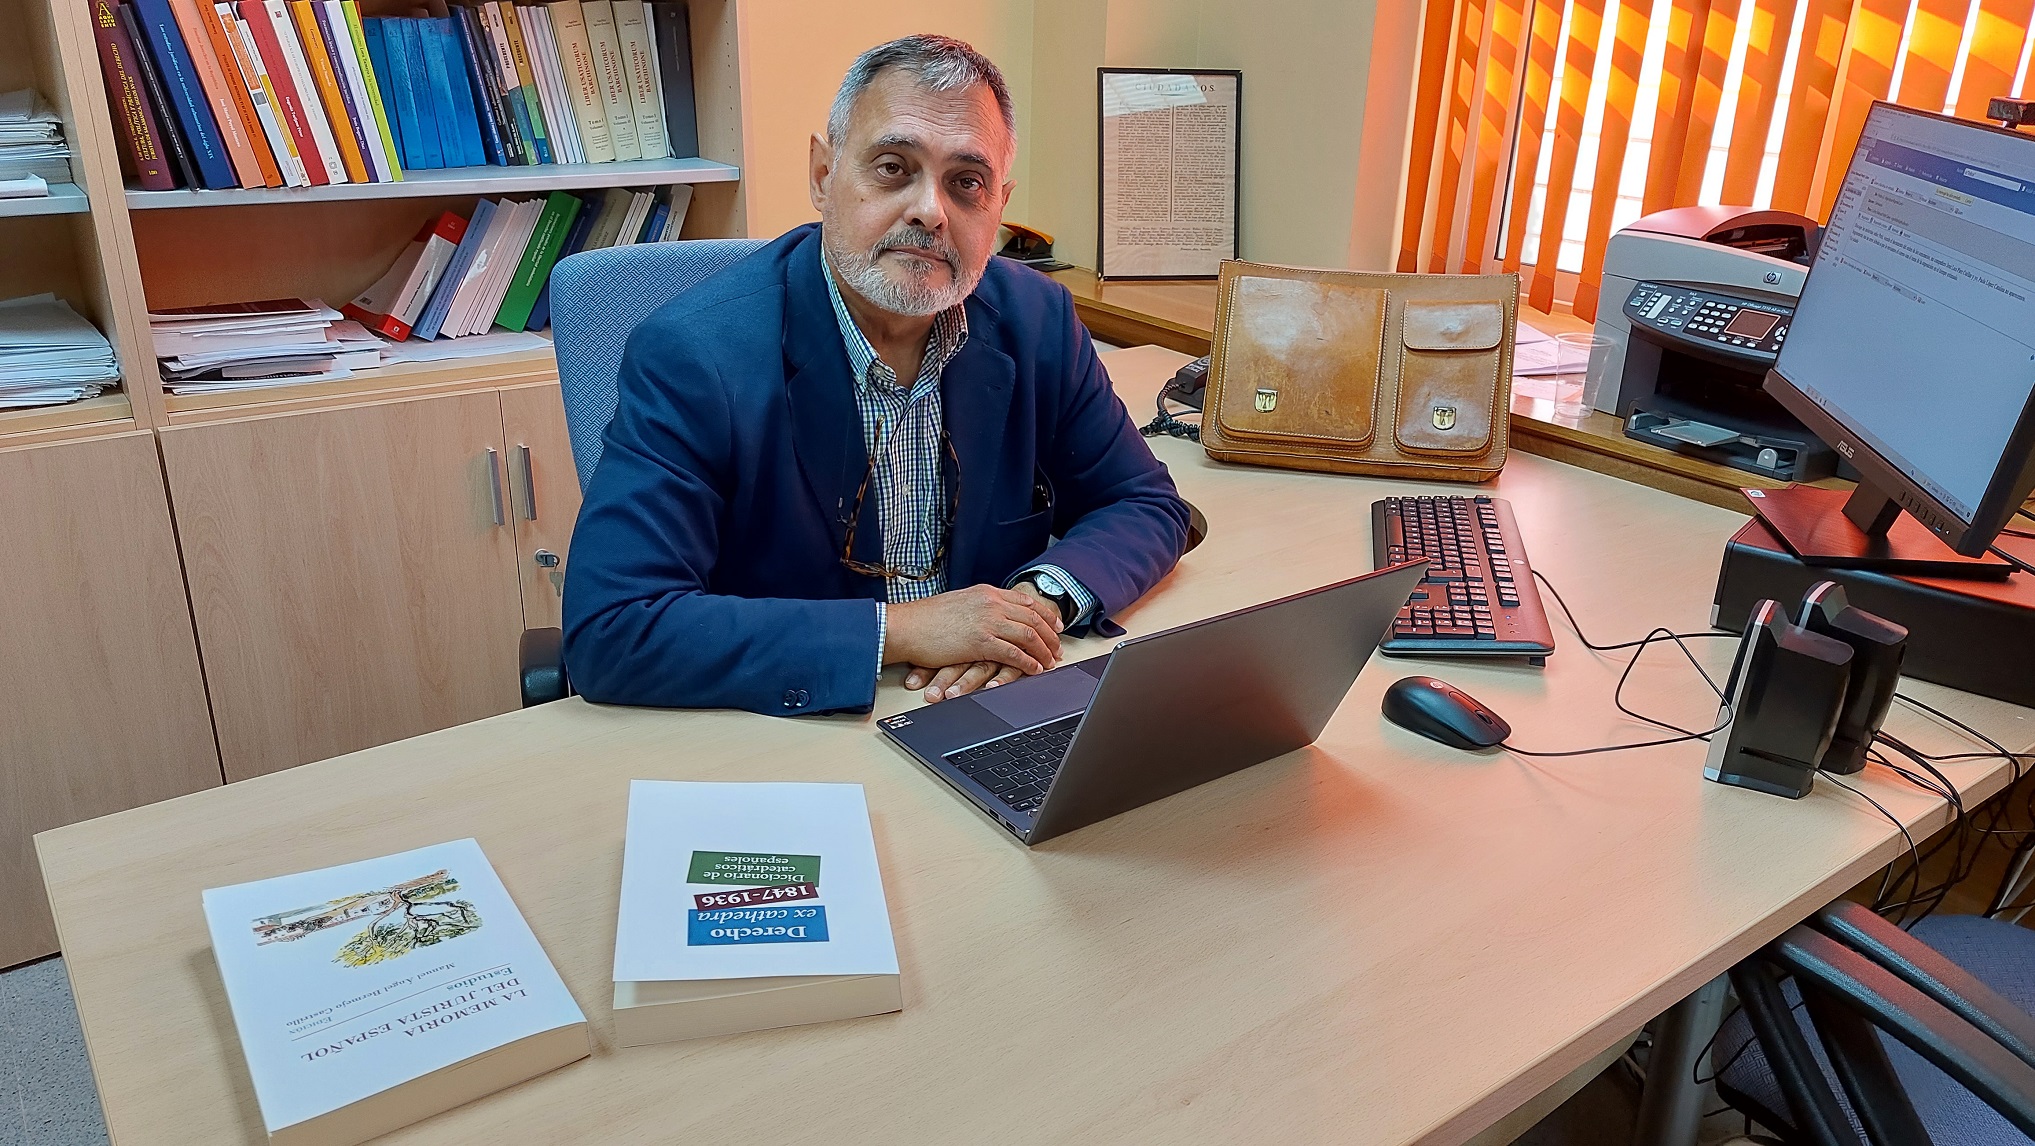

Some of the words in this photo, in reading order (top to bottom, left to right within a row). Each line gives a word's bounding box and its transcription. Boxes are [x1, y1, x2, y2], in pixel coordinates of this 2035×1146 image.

[111, 42, 122, 69] DERECHO
[572, 42, 585, 85] USATICORUM
[600, 41, 613, 83] USATICORUM
[630, 41, 641, 82] USATICORUM
[582, 51, 593, 94] BARCHINONE
[610, 49, 620, 92] BARCHINONE
[639, 50, 649, 92] BARCHINONE
[162, 32, 172, 50] estudios
[168, 50, 179, 70] jurídicos
[181, 82, 194, 107] universidad
[202, 138, 210, 150] siglo
[582, 86, 590, 106] LIBER
[609, 84, 617, 104] LIBER
[284, 95, 294, 112] Eugenia
[402, 302, 410, 316] Derechos
[409, 289, 419, 304] procesales
[416, 269, 429, 289] fundamentales
[1837, 440, 1855, 459] ASUS
[714, 863, 796, 872] catedráticos
[724, 856, 788, 865] españoles
[703, 871, 720, 880] de
[724, 872, 805, 882] Diccionario
[702, 884, 810, 906] 1847-1936
[698, 908, 788, 924] cathedra
[794, 908, 816, 918] ex
[710, 926, 807, 940] Derecho
[417, 962, 456, 980] Manuel
[446, 966, 514, 991] Estudios
[383, 975, 414, 992] Ángel
[484, 977, 520, 996] DEL
[337, 985, 382, 1010] Bermejo
[397, 988, 476, 1025] JURISTA
[504, 988, 528, 1006] LA
[285, 1007, 335, 1027] Castrillo
[403, 998, 498, 1038] MEMORIA
[300, 1022, 393, 1063] ESPAÑOL
